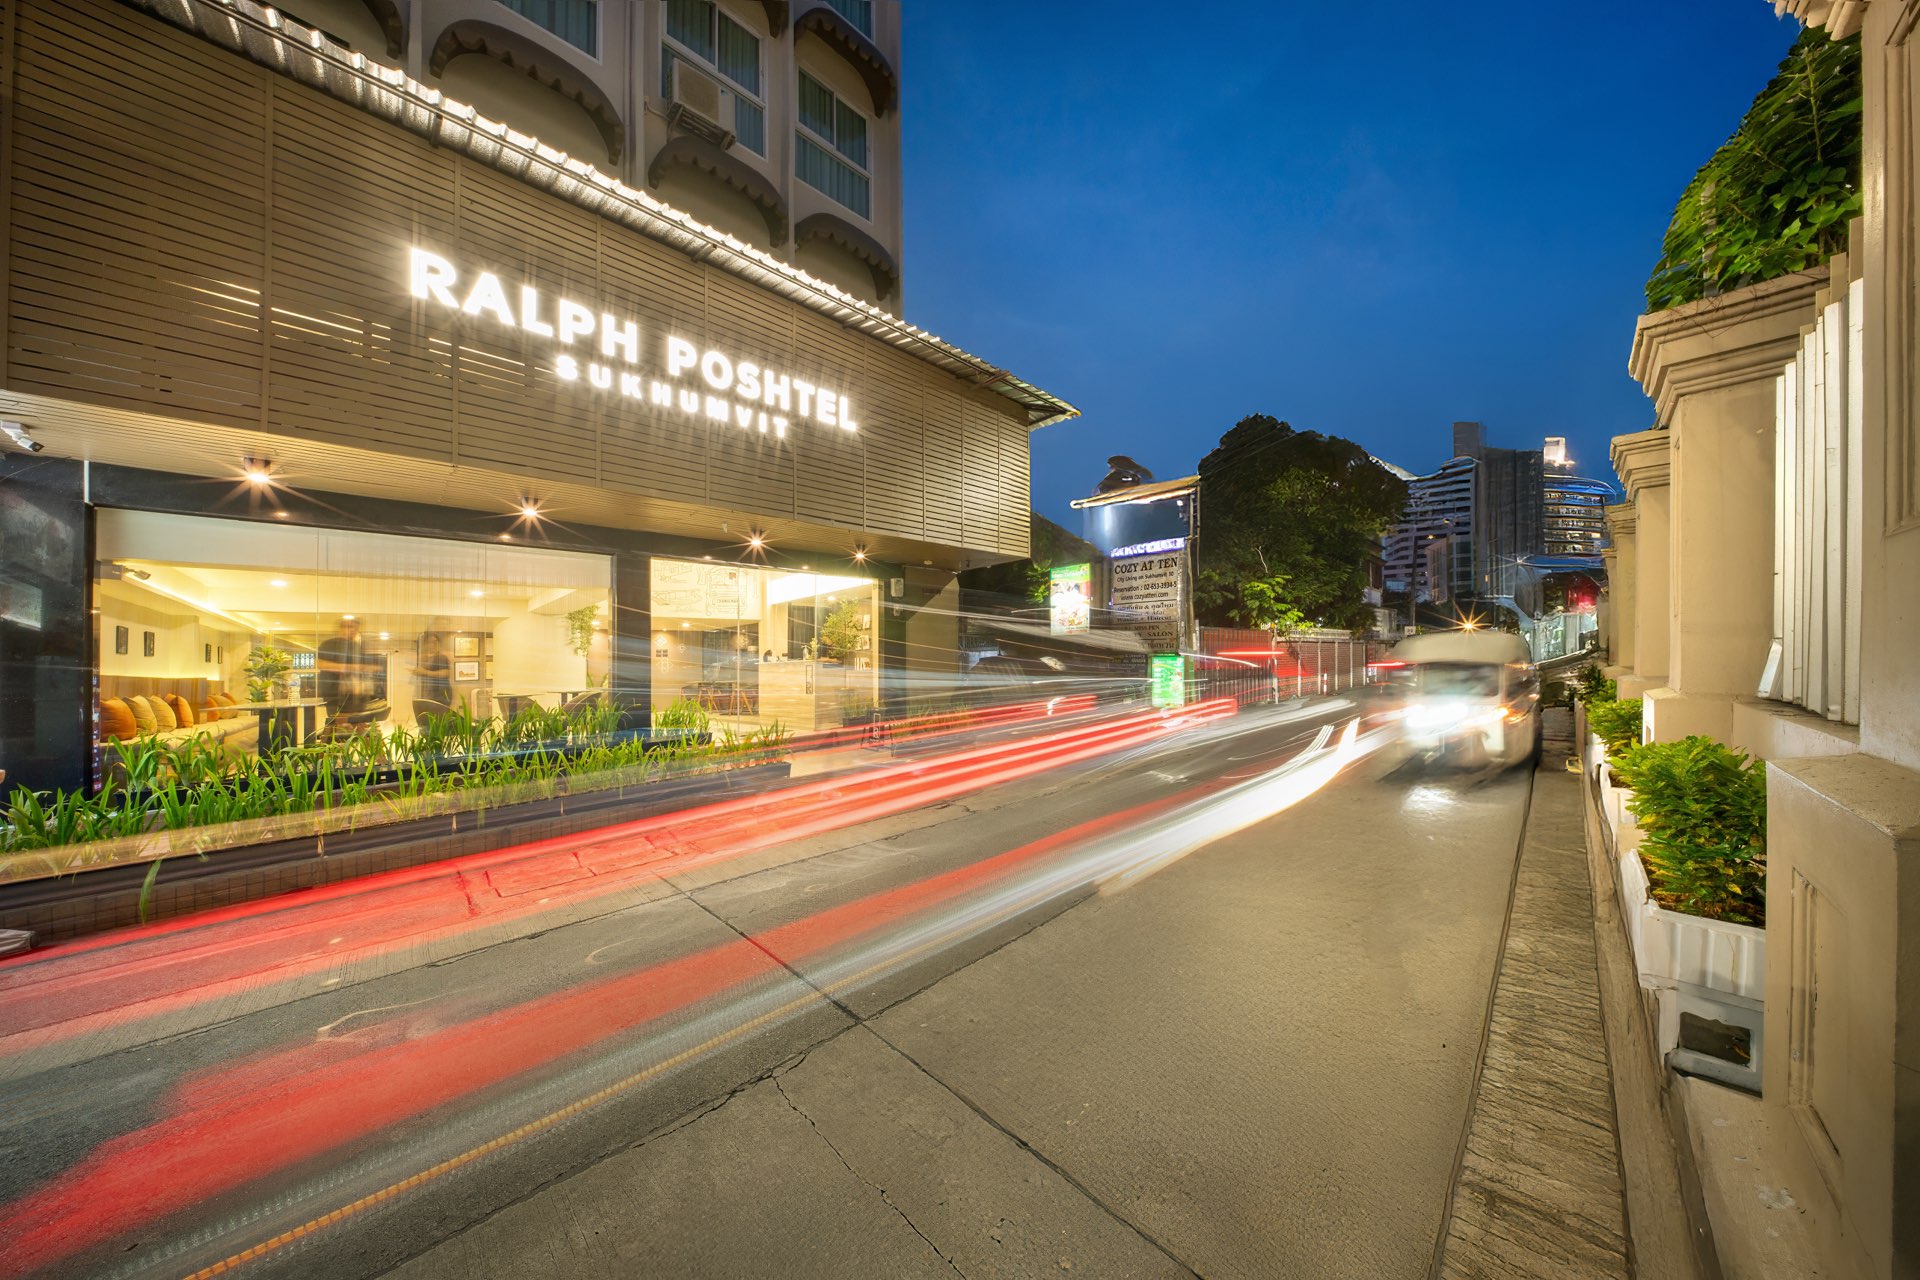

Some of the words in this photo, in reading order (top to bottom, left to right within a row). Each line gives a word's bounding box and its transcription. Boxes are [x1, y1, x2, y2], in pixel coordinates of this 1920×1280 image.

[410, 247, 638, 363] RALPH
[667, 335, 857, 432] POSHTEL
[556, 356, 788, 438] SUKHUMVIT
[1114, 562, 1139, 575] COZY
[1140, 560, 1154, 572] AT
[1157, 557, 1178, 569] TEN
